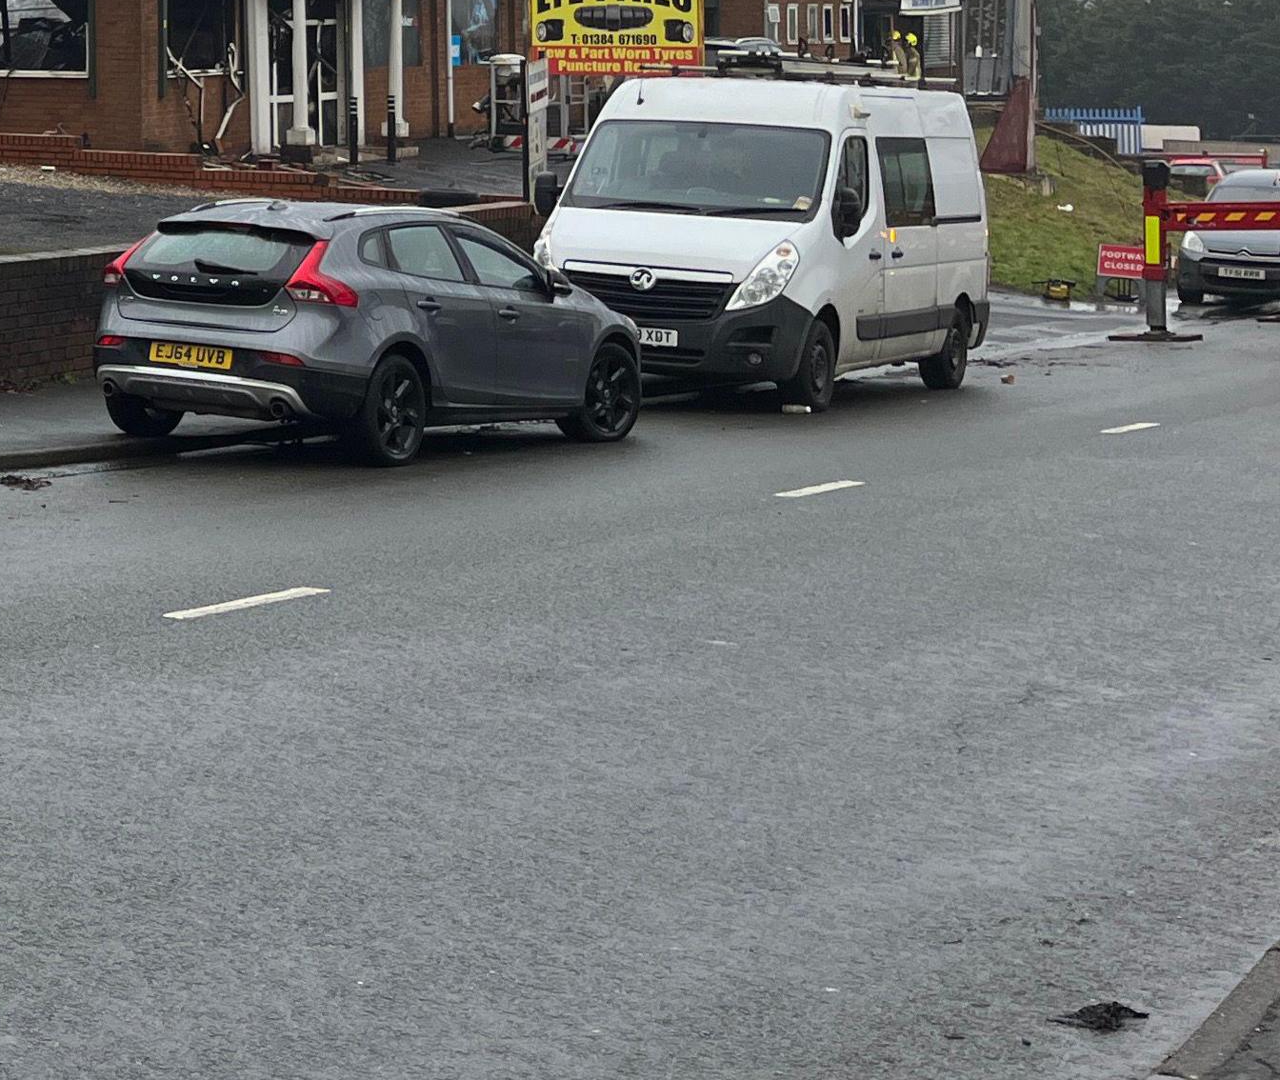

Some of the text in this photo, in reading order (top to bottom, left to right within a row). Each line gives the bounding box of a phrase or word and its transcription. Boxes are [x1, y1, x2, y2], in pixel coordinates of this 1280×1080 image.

[571, 33, 657, 46] T: 01384 671690
[537, 46, 693, 61] ew & Part Worn Tyres
[558, 59, 621, 73] Puncture
[1103, 260, 1144, 271] CLOSED
[646, 329, 672, 343] XDT
[155, 343, 226, 364] EJ64 UVB
